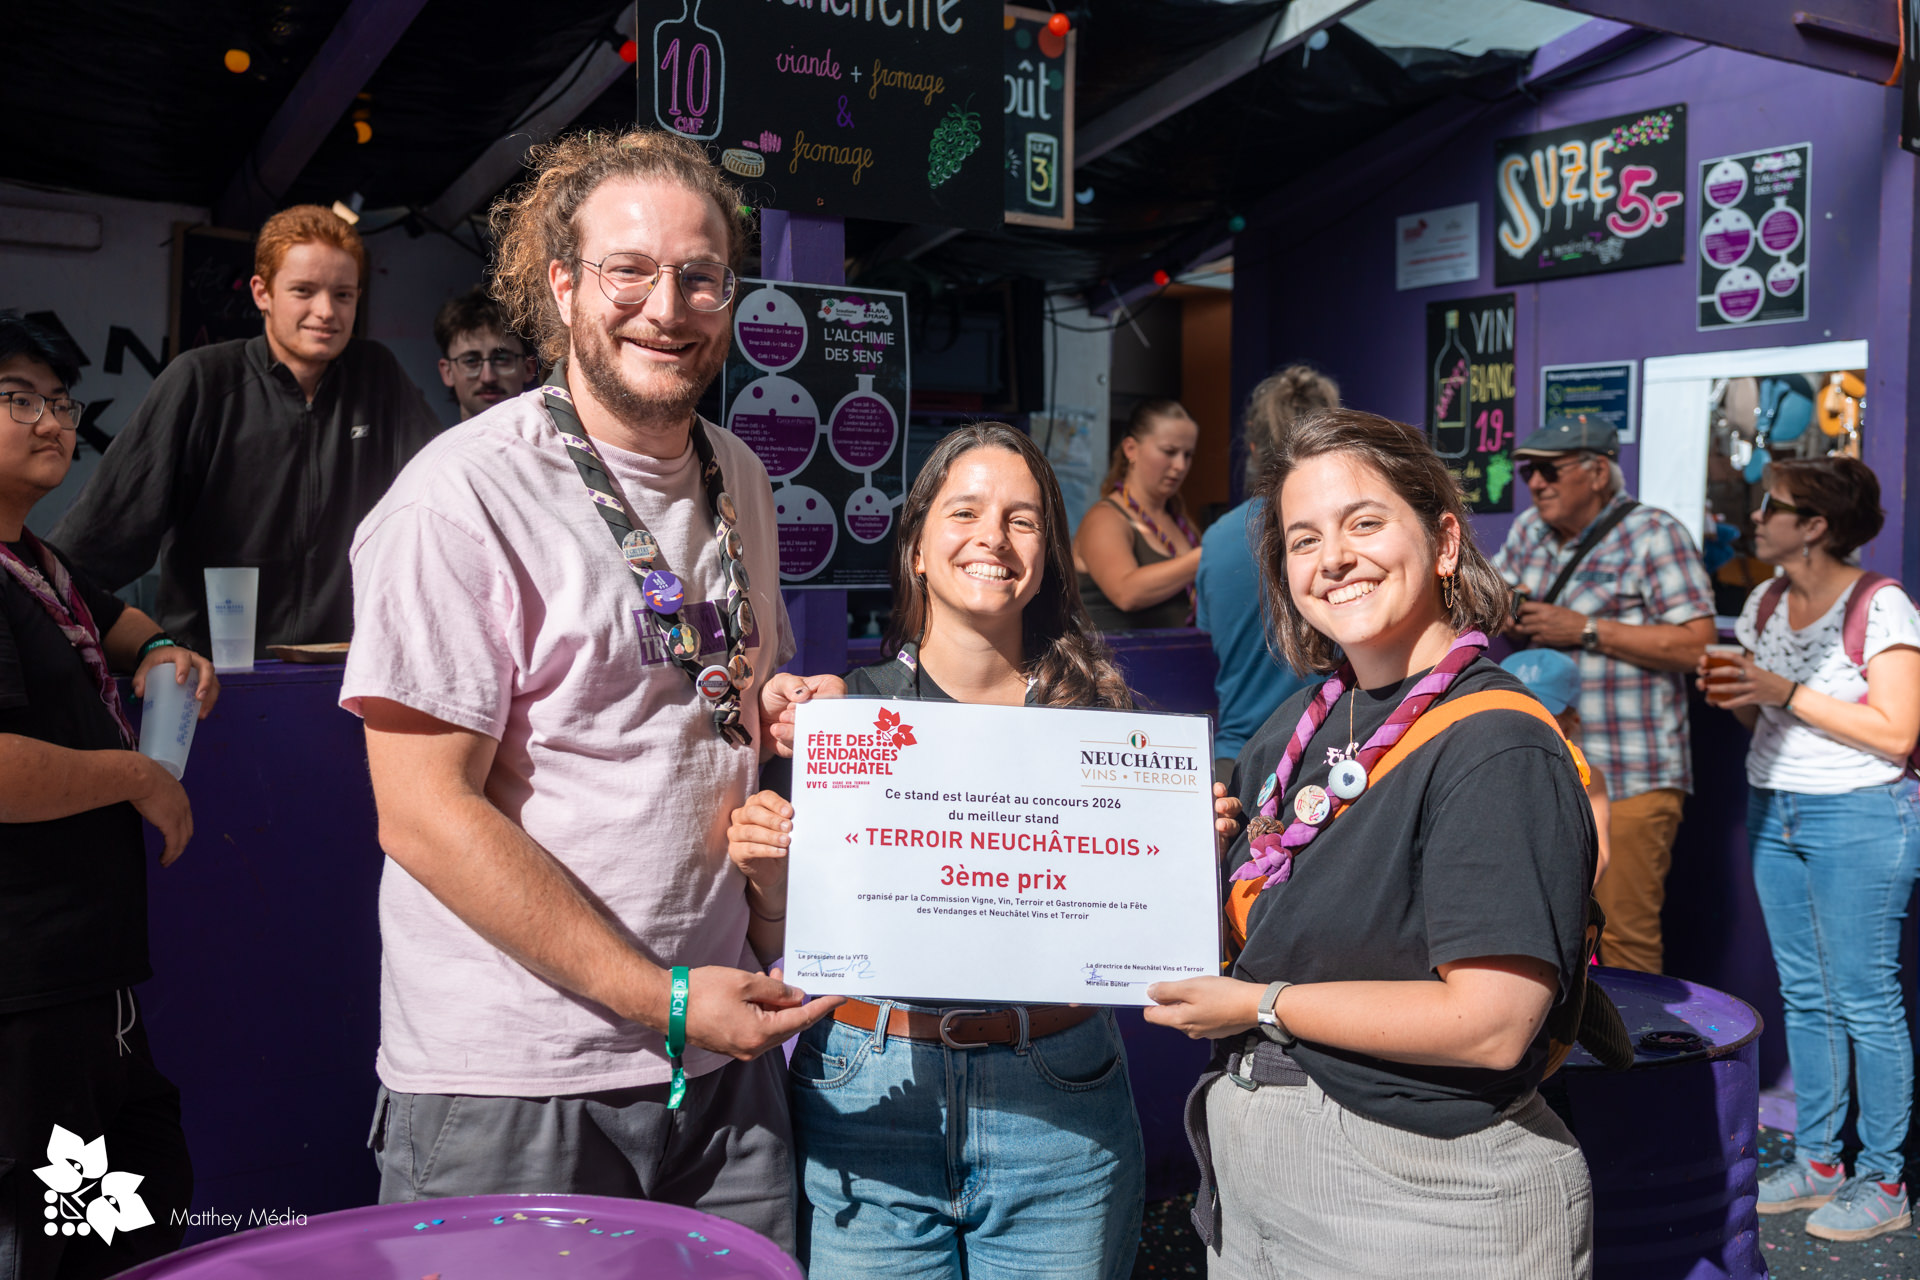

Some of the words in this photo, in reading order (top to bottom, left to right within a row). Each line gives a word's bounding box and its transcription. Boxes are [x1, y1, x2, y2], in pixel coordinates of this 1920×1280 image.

[661, 38, 710, 117] 10
[776, 45, 842, 80] viande
[869, 58, 945, 106] fromage
[837, 95, 855, 128] &
[674, 116, 704, 134] CHF
[789, 130, 874, 185] fromage
[1031, 156, 1049, 191] 3
[1499, 137, 1617, 259] SUZE
[824, 327, 895, 345] L'ALCHIMIE
[1470, 306, 1514, 354] VIN
[825, 347, 849, 362] DES
[852, 349, 883, 364] SENS
[808, 730, 842, 747] FÊTE
[846, 734, 874, 747] DES
[807, 748, 898, 762] VENDANGES
[1081, 750, 1198, 771] NEUCHÂTEL
[807, 758, 893, 775] NEUCHÂTEL
[1081, 767, 1117, 781] VINS
[1134, 771, 1197, 786] TERROIR
[806, 781, 828, 789] VVTG
[886, 789, 900, 799] Ce
[904, 790, 939, 801] stand
[943, 792, 962, 801] est
[966, 791, 1010, 804] lauréat
[1014, 795, 1029, 805] au
[1033, 796, 1089, 807] concours
[1092, 797, 1121, 809] 2026
[949, 810, 963, 821] du
[968, 811, 1021, 823] meilleur
[1025, 813, 1059, 824] stand
[866, 828, 963, 849] TERROIR
[971, 830, 1140, 856] NEUCHÂTELOIS
[941, 864, 1009, 888] 3ème
[1018, 869, 1067, 893] prix
[857, 893, 892, 901] organisé
[895, 895, 908, 903] par
[911, 894, 918, 902] la
[921, 895, 969, 904] Commission
[972, 896, 996, 906] Vigne,
[998, 897, 1013, 906] Vin,
[1015, 898, 1044, 907] Terroir
[1046, 899, 1054, 907] et
[1056, 899, 1107, 909] Gastronomie
[1109, 901, 1118, 909] de
[1120, 901, 1128, 910] la
[1130, 901, 1147, 910] Fête
[933, 907, 977, 917] Vendanges
[979, 909, 987, 917] et
[989, 909, 1029, 918] Neuchâtel
[1031, 910, 1049, 919] Vins
[1051, 911, 1058, 919] et
[1061, 911, 1089, 920] Terroir
[672, 990, 684, 1016] BCN
